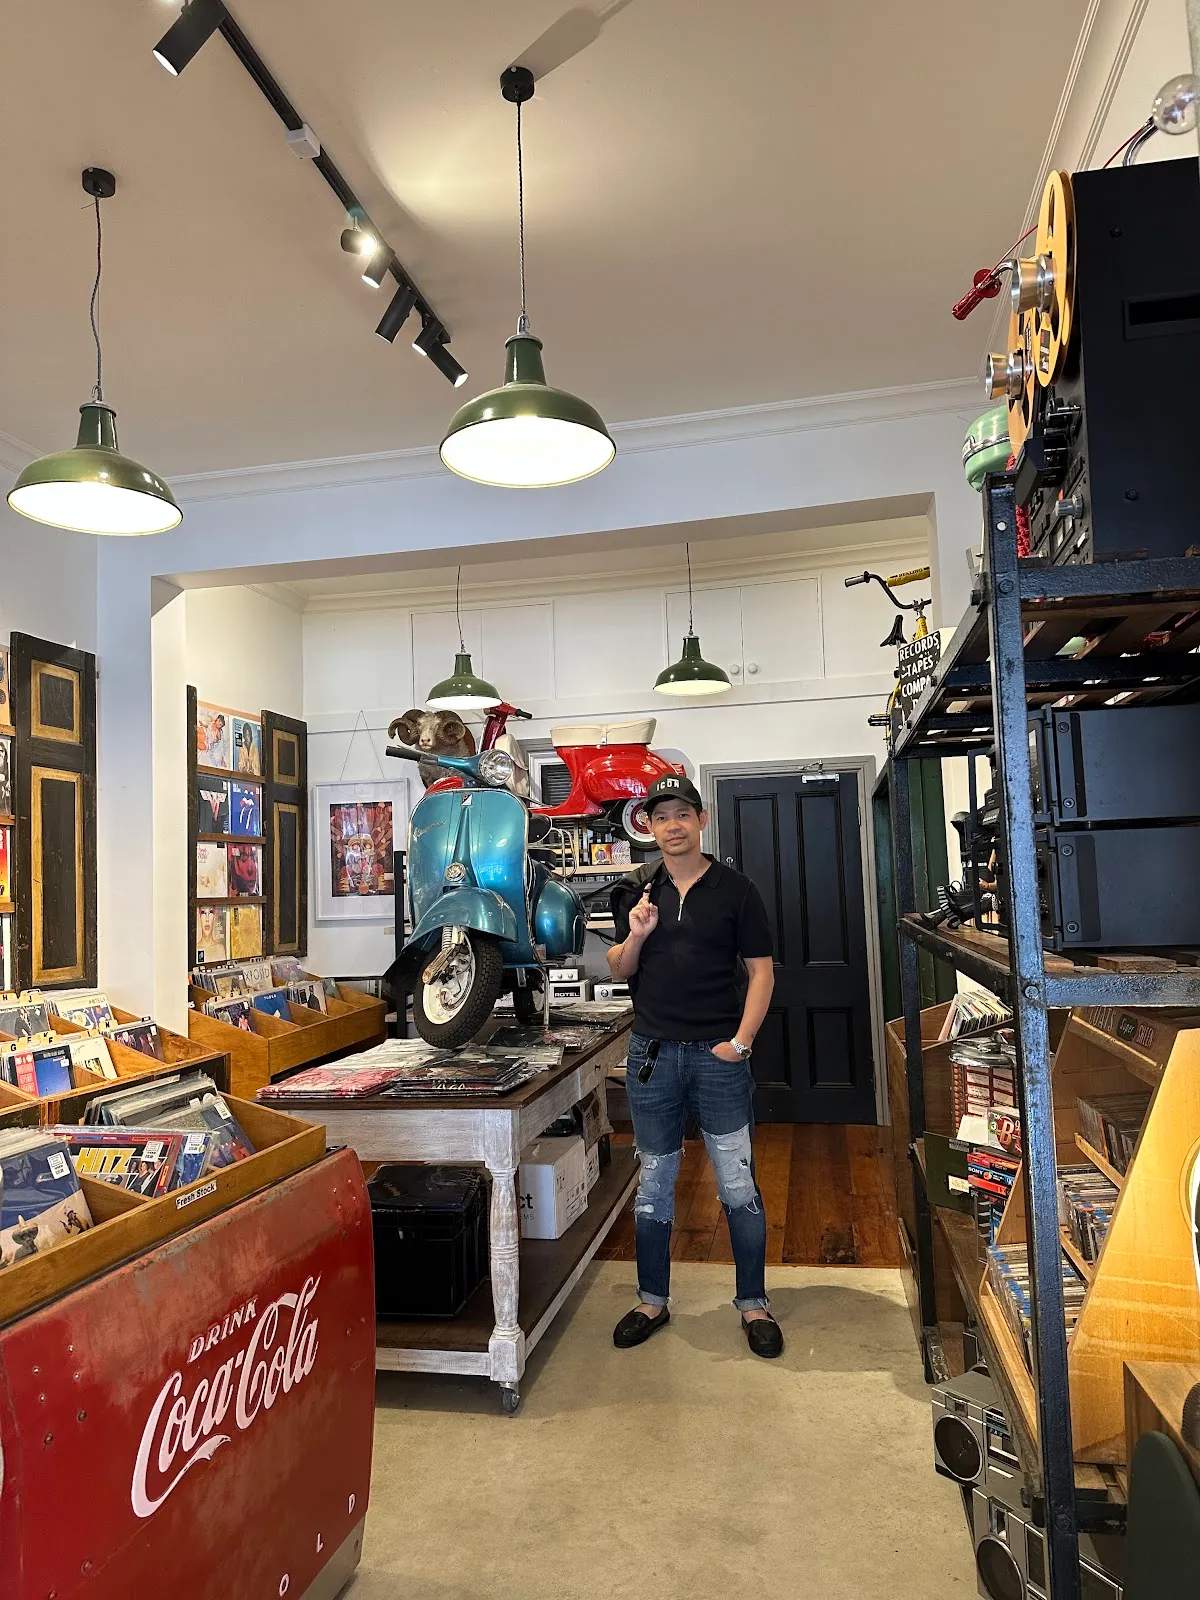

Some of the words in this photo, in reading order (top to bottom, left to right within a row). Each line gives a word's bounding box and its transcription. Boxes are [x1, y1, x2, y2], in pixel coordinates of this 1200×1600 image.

[907, 655, 934, 676] TAPES
[656, 778, 680, 791] ICON
[75, 1147, 136, 1174] HITZ
[967, 1166, 984, 1176] SONY
[176, 1192, 196, 1206] Fresh
[196, 1183, 215, 1198] Stock
[186, 1297, 258, 1364] DRINK
[131, 1273, 321, 1518] Coca-Cola
